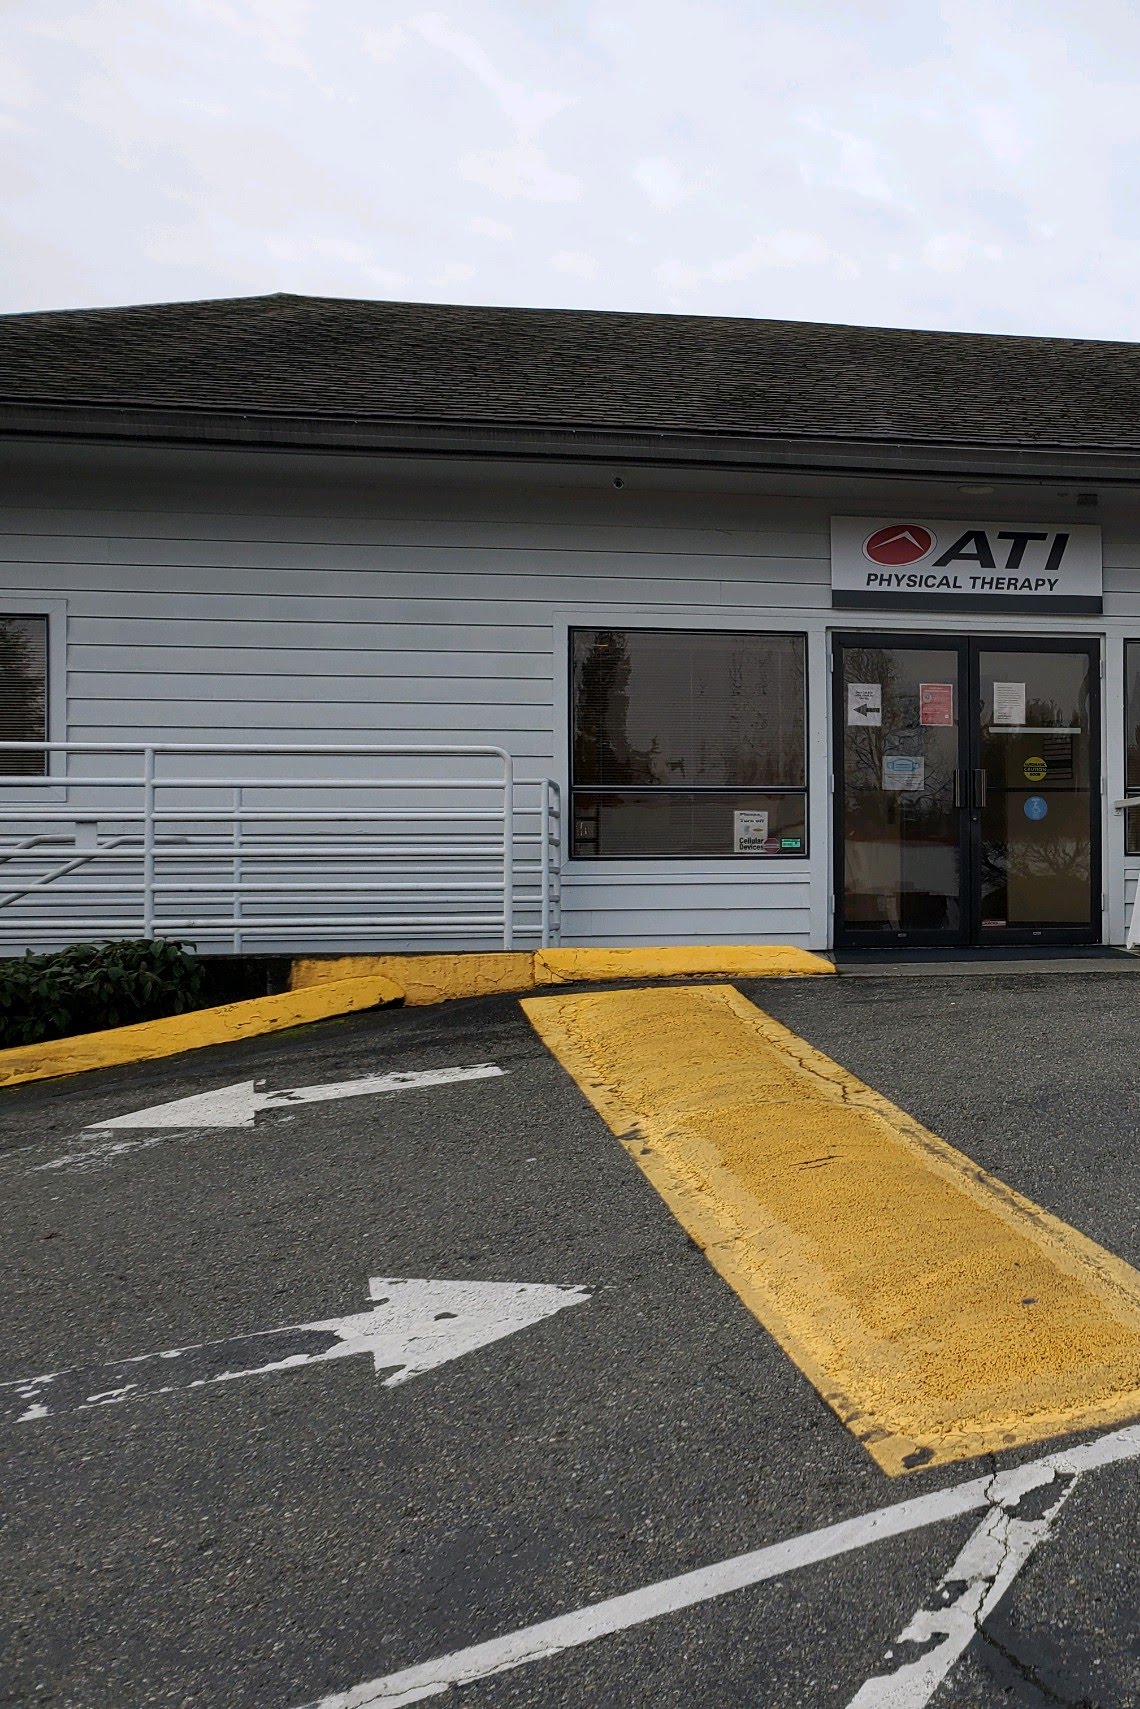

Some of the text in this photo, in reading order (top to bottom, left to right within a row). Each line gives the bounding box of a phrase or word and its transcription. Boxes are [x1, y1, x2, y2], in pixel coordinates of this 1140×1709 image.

[931, 530, 1071, 571] ATI
[866, 573, 1060, 592] PHYSICAL THERAPY
[739, 837, 764, 845] Cellular
